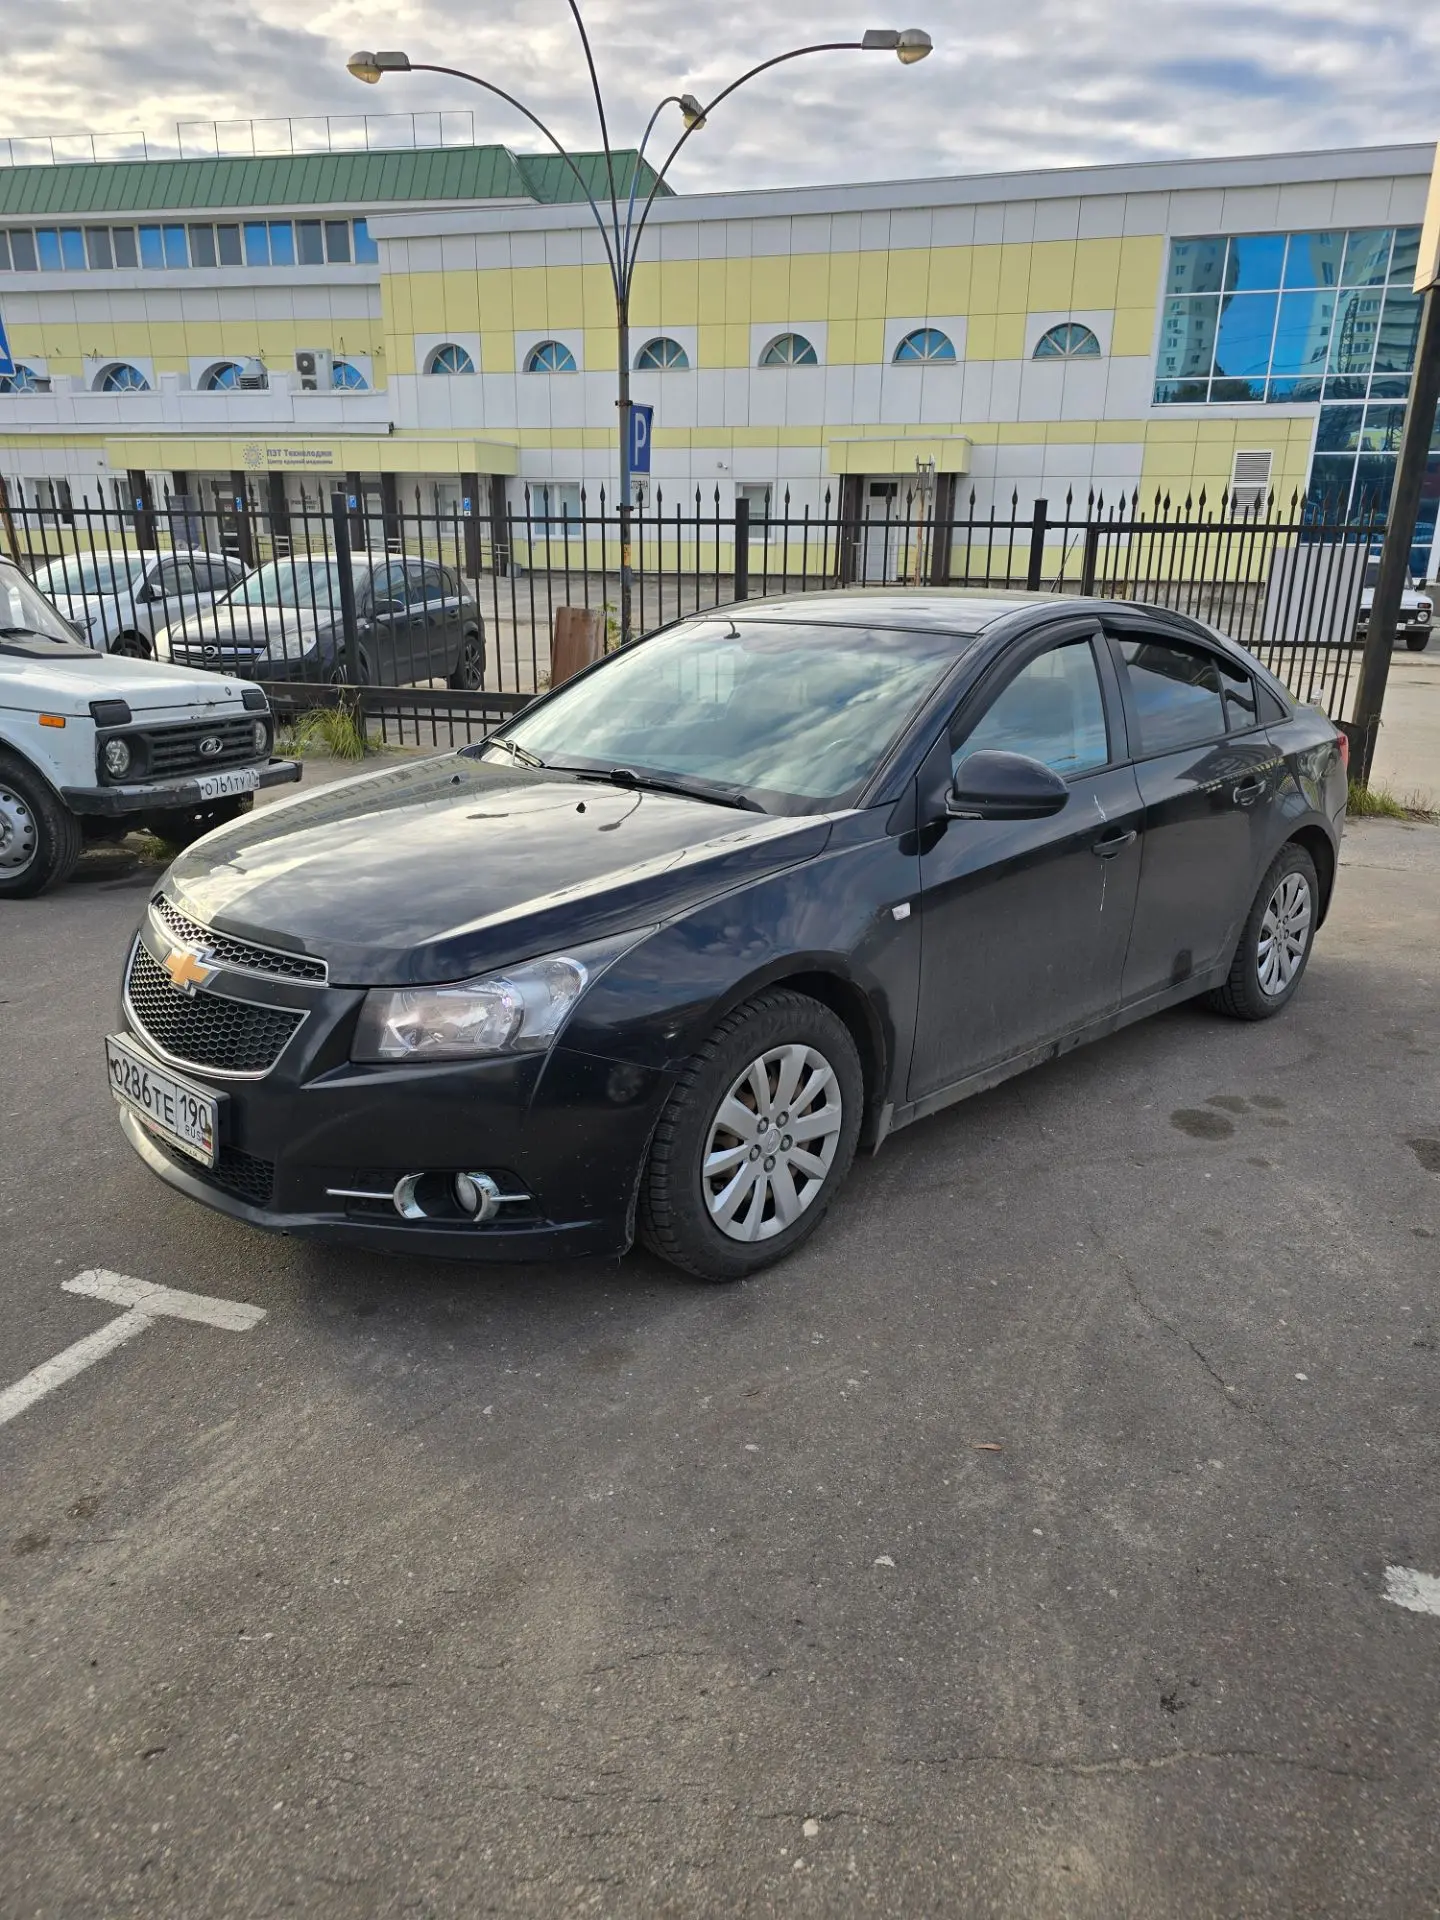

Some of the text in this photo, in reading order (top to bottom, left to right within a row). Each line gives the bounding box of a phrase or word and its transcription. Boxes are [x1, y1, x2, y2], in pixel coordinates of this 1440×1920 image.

[266, 449, 282, 457] ПЭТ
[634, 412, 647, 466] P
[180, 1094, 208, 1132] 190
[184, 1124, 204, 1142] RUS
